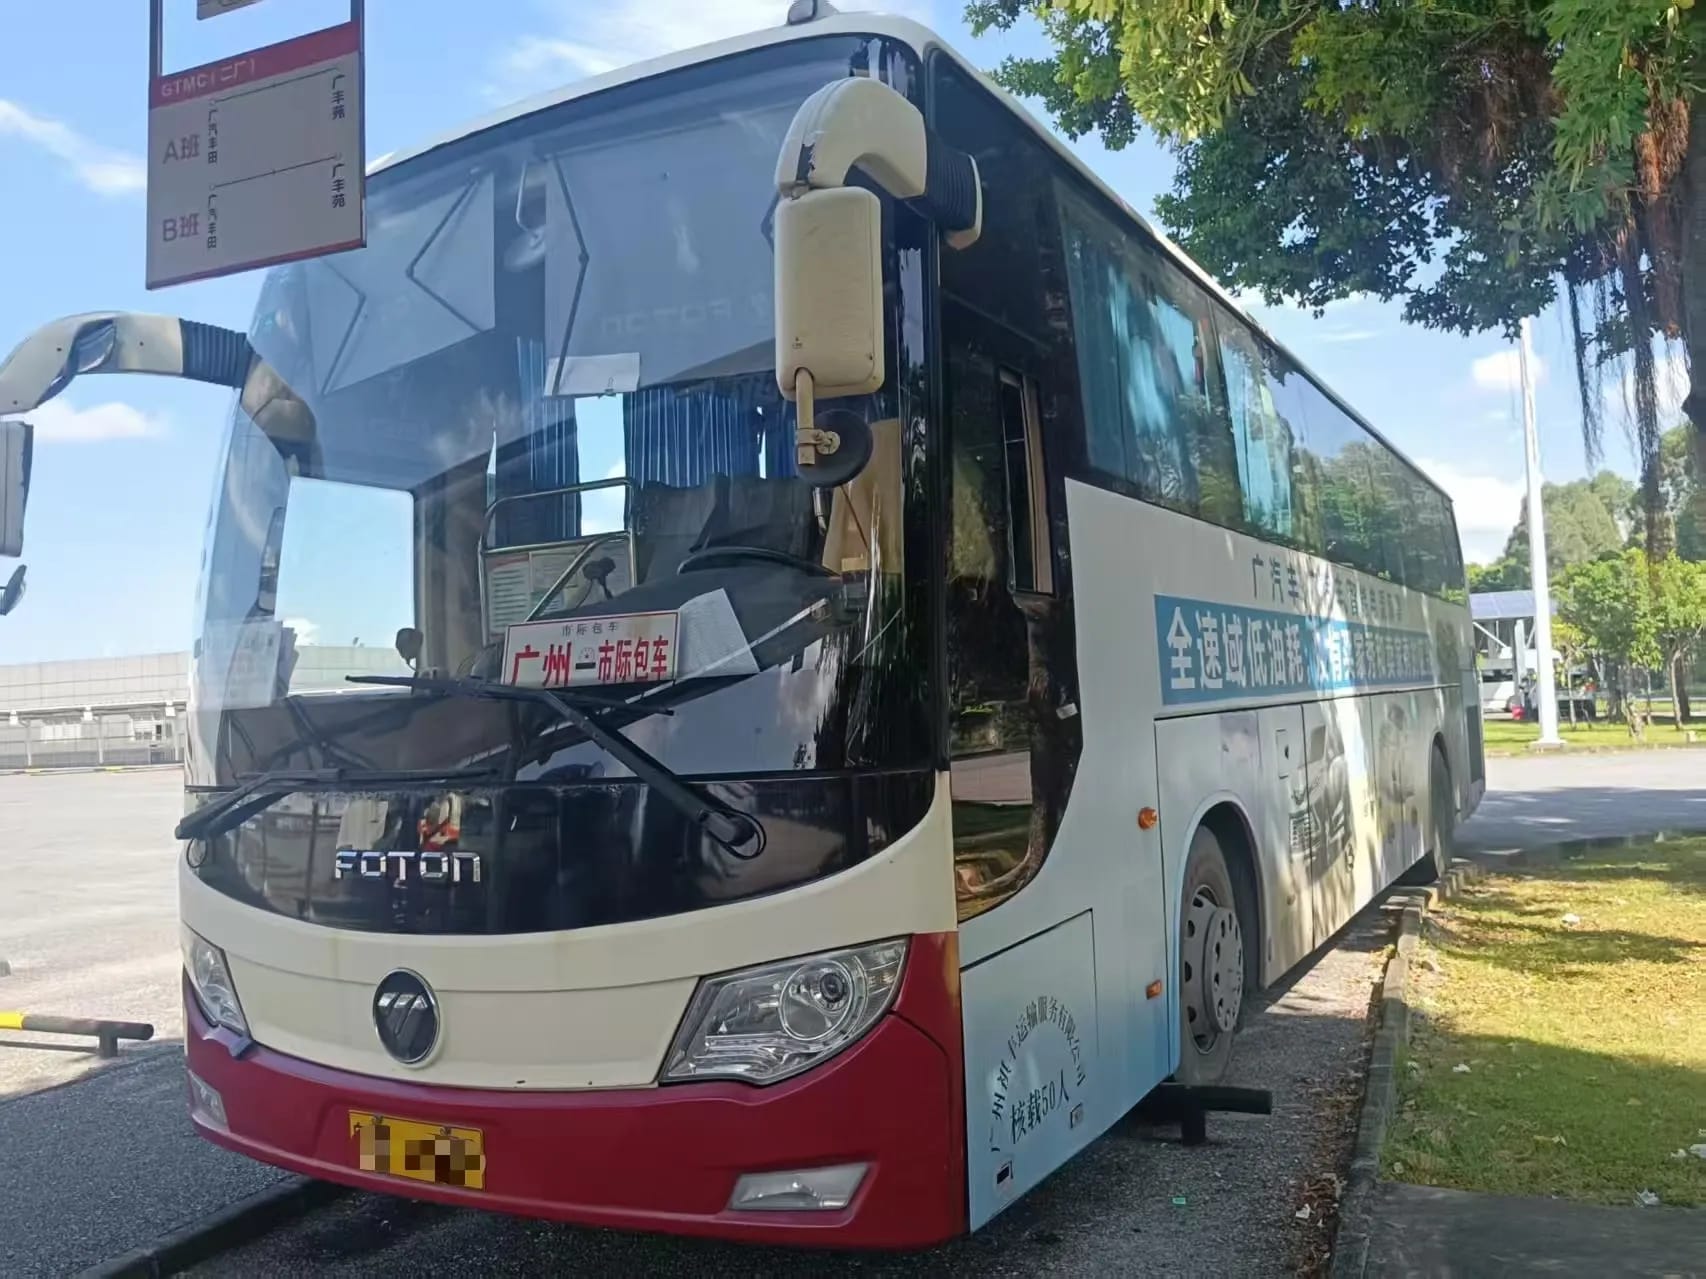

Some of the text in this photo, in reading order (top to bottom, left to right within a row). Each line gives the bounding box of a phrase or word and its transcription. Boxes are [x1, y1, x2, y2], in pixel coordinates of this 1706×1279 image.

[162, 133, 200, 164] A班
[162, 212, 200, 242] B班
[335, 851, 481, 883] FOTON
[1011, 1069, 1069, 1145] 核载50人
